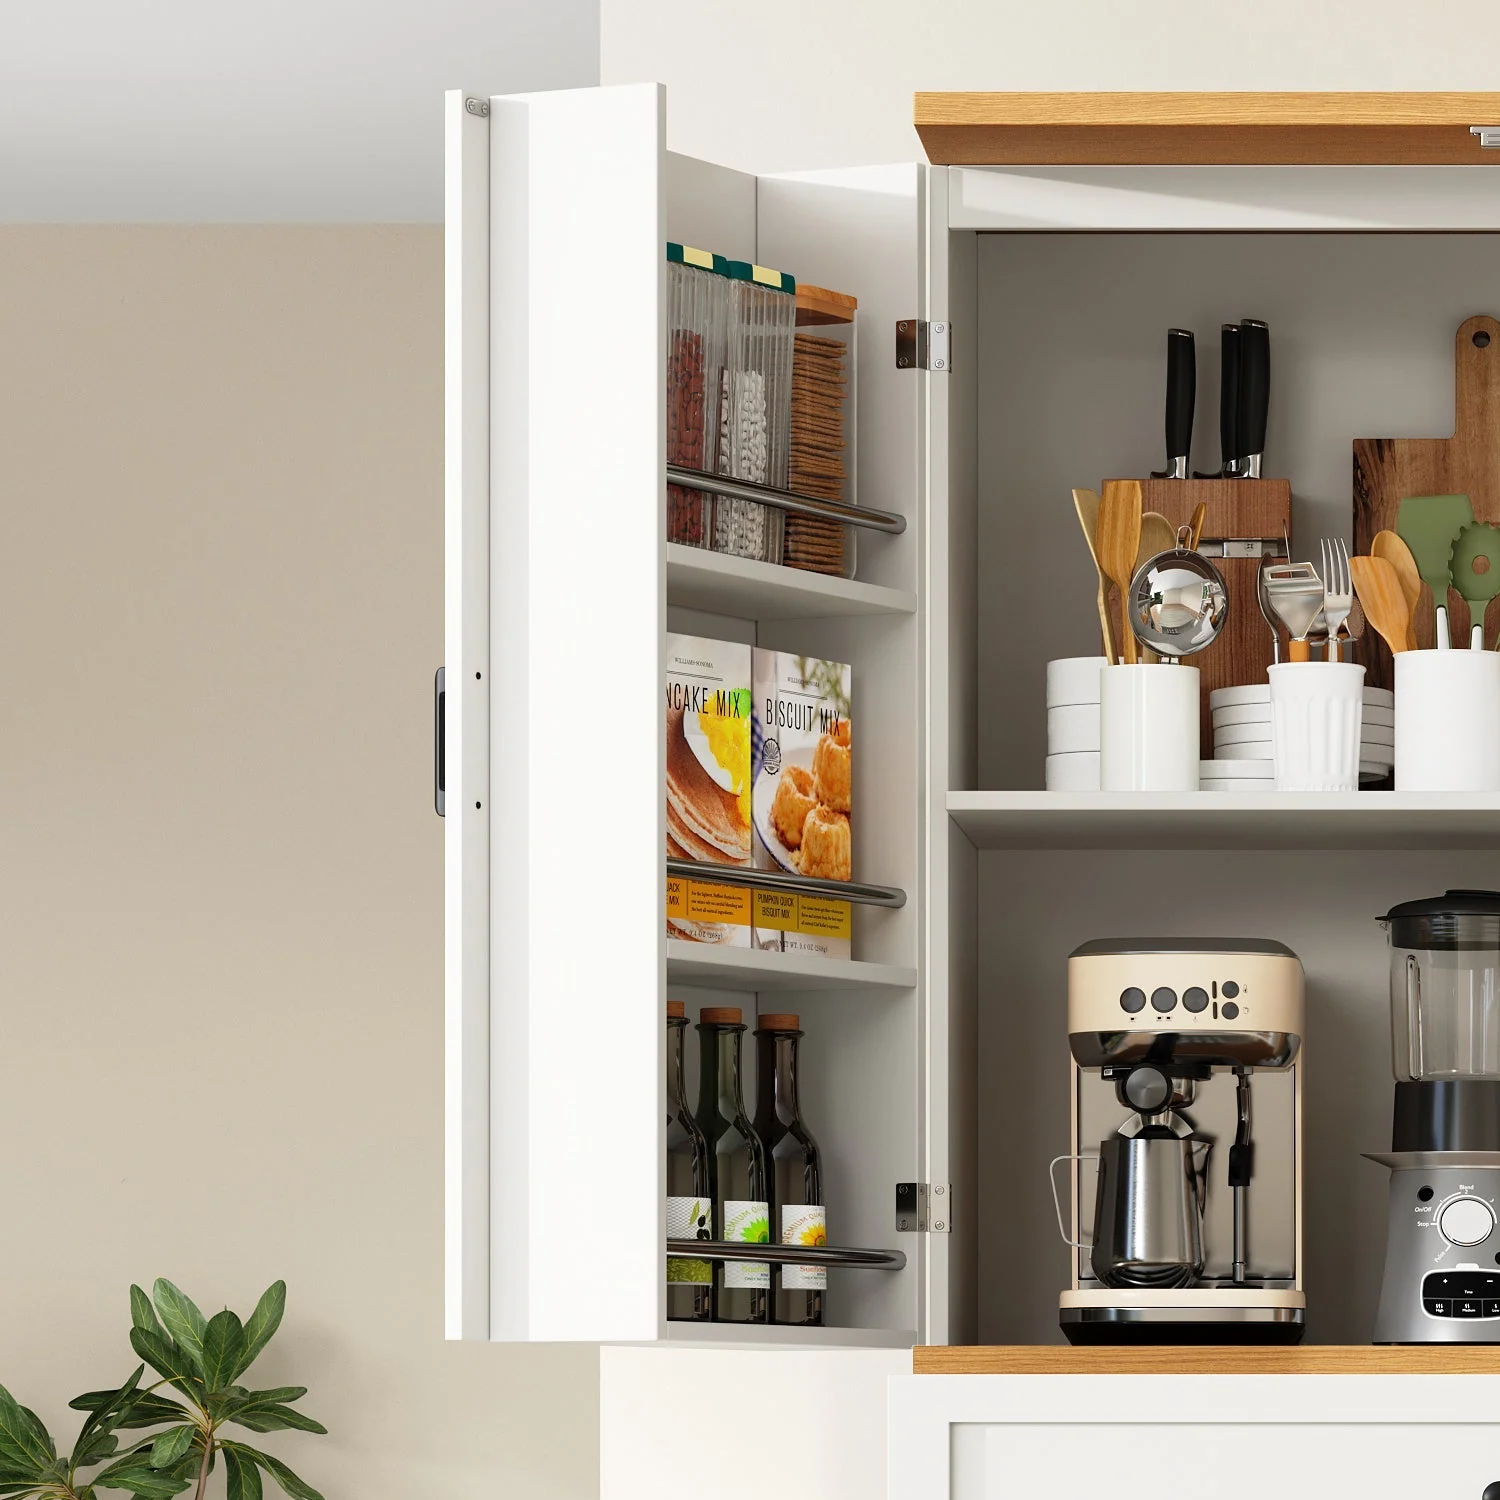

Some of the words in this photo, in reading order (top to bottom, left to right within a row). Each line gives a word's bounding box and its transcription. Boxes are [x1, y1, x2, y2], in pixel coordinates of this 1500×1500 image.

[716, 690, 740, 719] MIX
[766, 698, 814, 732] BISCUIT
[820, 708, 840, 736] MIX
[758, 894, 779, 905] PUMPKIN
[780, 896, 794, 906] QUICK
[762, 907, 780, 918] BISCUIT
[782, 909, 790, 919] MIX
